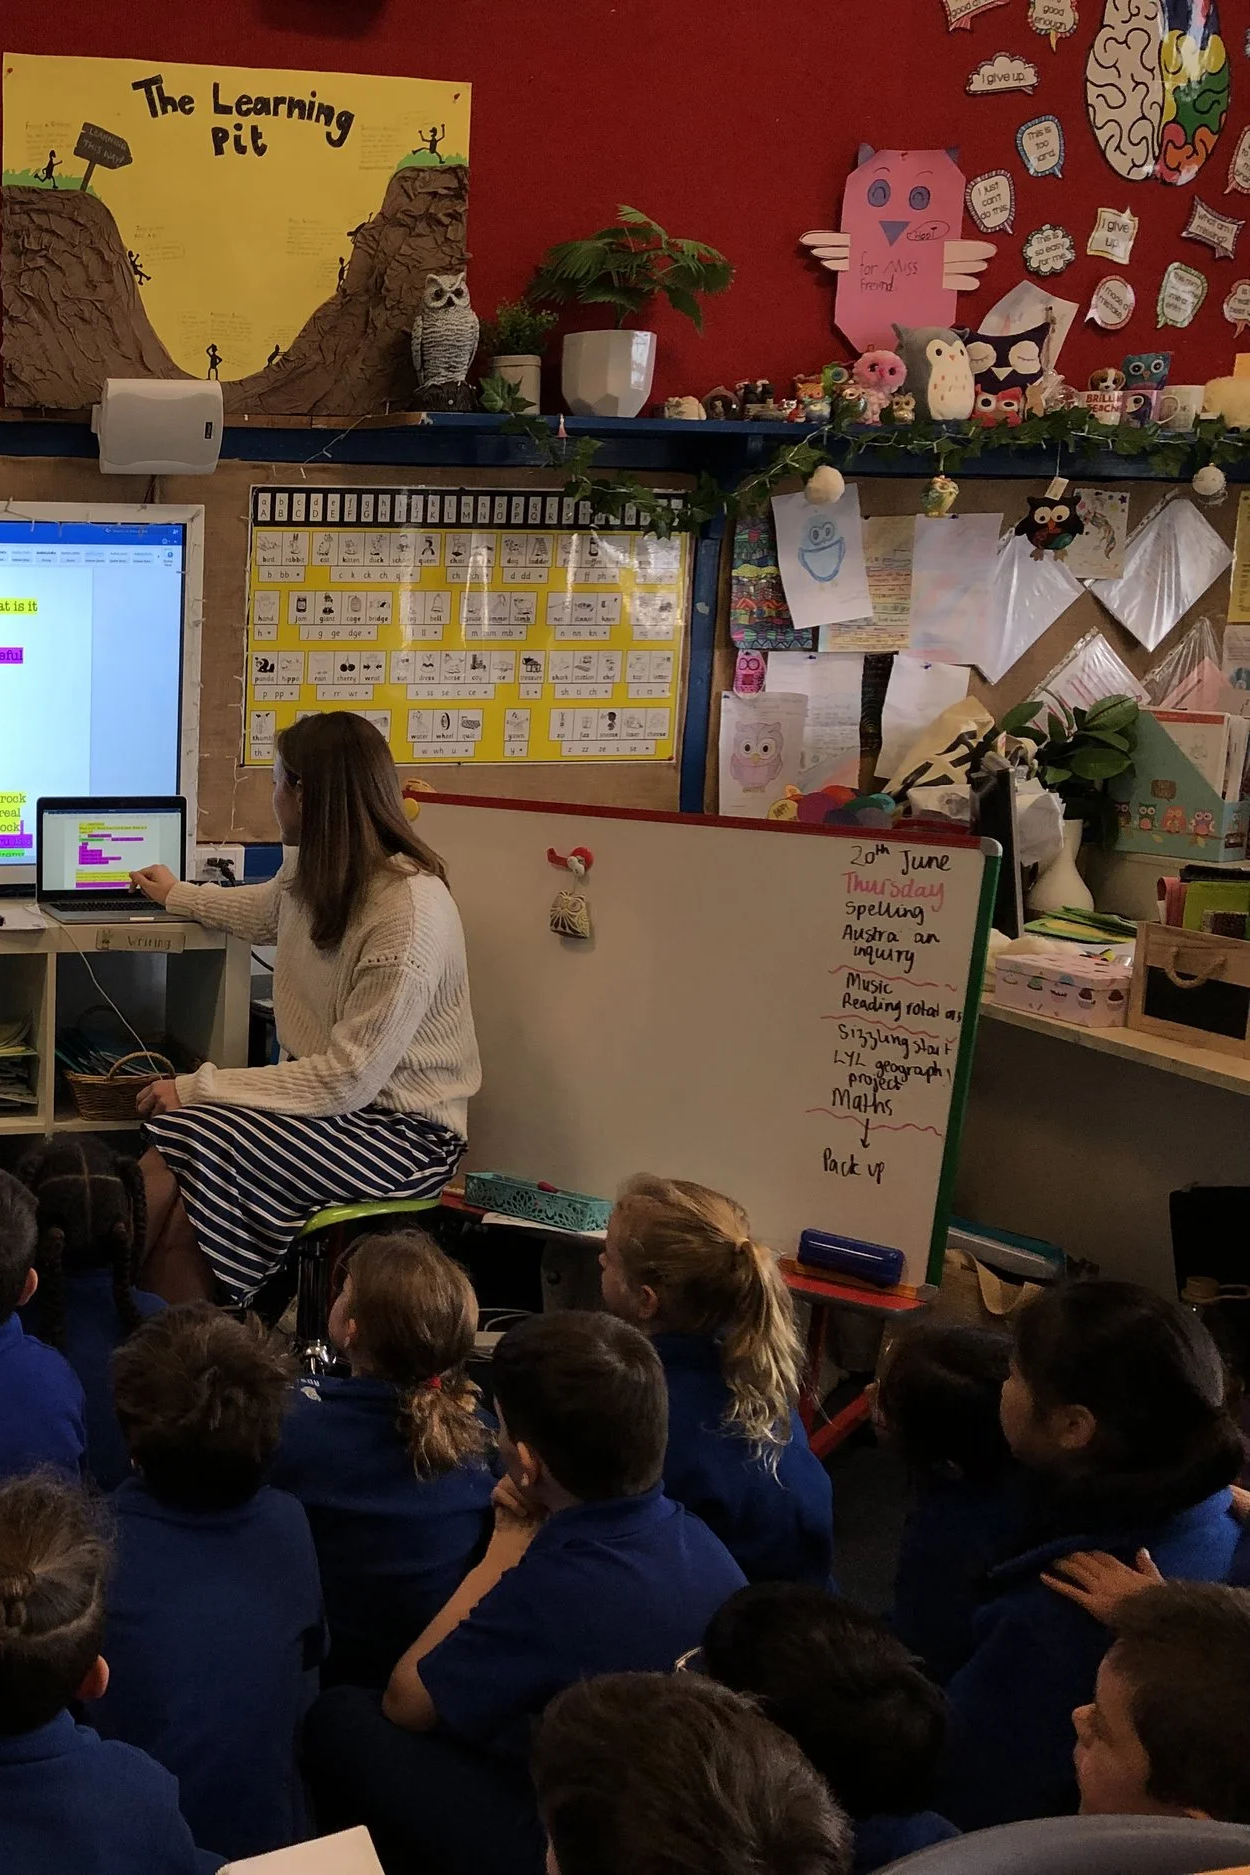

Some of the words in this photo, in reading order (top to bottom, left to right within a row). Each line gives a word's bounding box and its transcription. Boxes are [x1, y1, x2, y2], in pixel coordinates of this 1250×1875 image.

[987, 73, 1010, 85] give
[131, 74, 194, 119] The
[213, 82, 355, 148] Learning
[1107, 221, 1130, 233] give
[14, 600, 24, 612] is
[28, 601, 38, 612] it
[0, 793, 26, 804] rock
[899, 850, 951, 875] June
[841, 871, 944, 912] Thursday
[845, 901, 924, 926] Spelling
[126, 935, 172, 949] Writing
[846, 972, 893, 994] Music
[842, 992, 901, 1022] Reading
[838, 1024, 909, 1059] Sizzling
[848, 1072, 903, 1093] project
[832, 1088, 893, 1116] Maths
[823, 1147, 861, 1177] Pack
[867, 1161, 885, 1184] up
